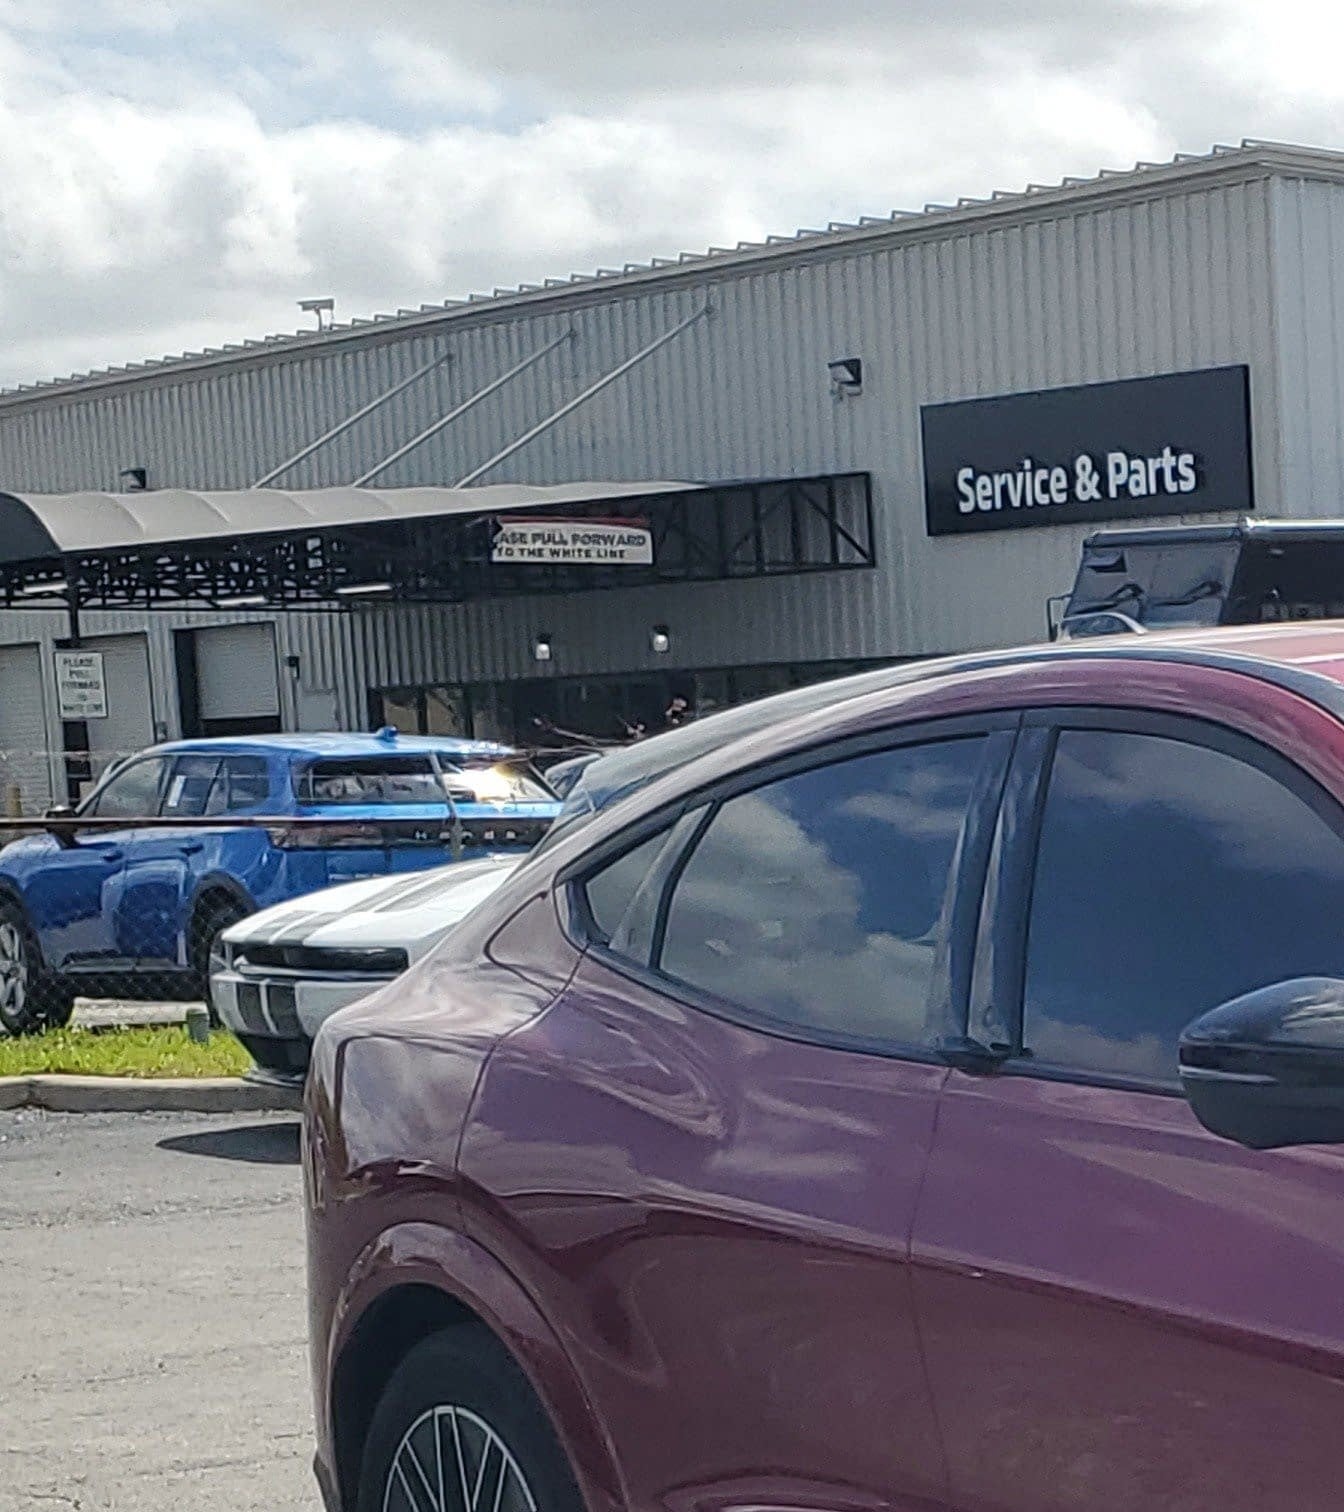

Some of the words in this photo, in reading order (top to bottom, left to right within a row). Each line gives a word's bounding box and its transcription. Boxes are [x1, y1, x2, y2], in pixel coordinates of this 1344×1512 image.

[957, 458, 1067, 514] Service
[1075, 454, 1102, 501] &
[1107, 446, 1196, 498] Parts
[500, 532, 528, 545] ASE
[531, 532, 568, 546] PULL
[571, 532, 646, 547] FORWARD
[519, 547, 545, 558] THE
[549, 548, 592, 559] WHITE
[597, 549, 626, 559] LINE
